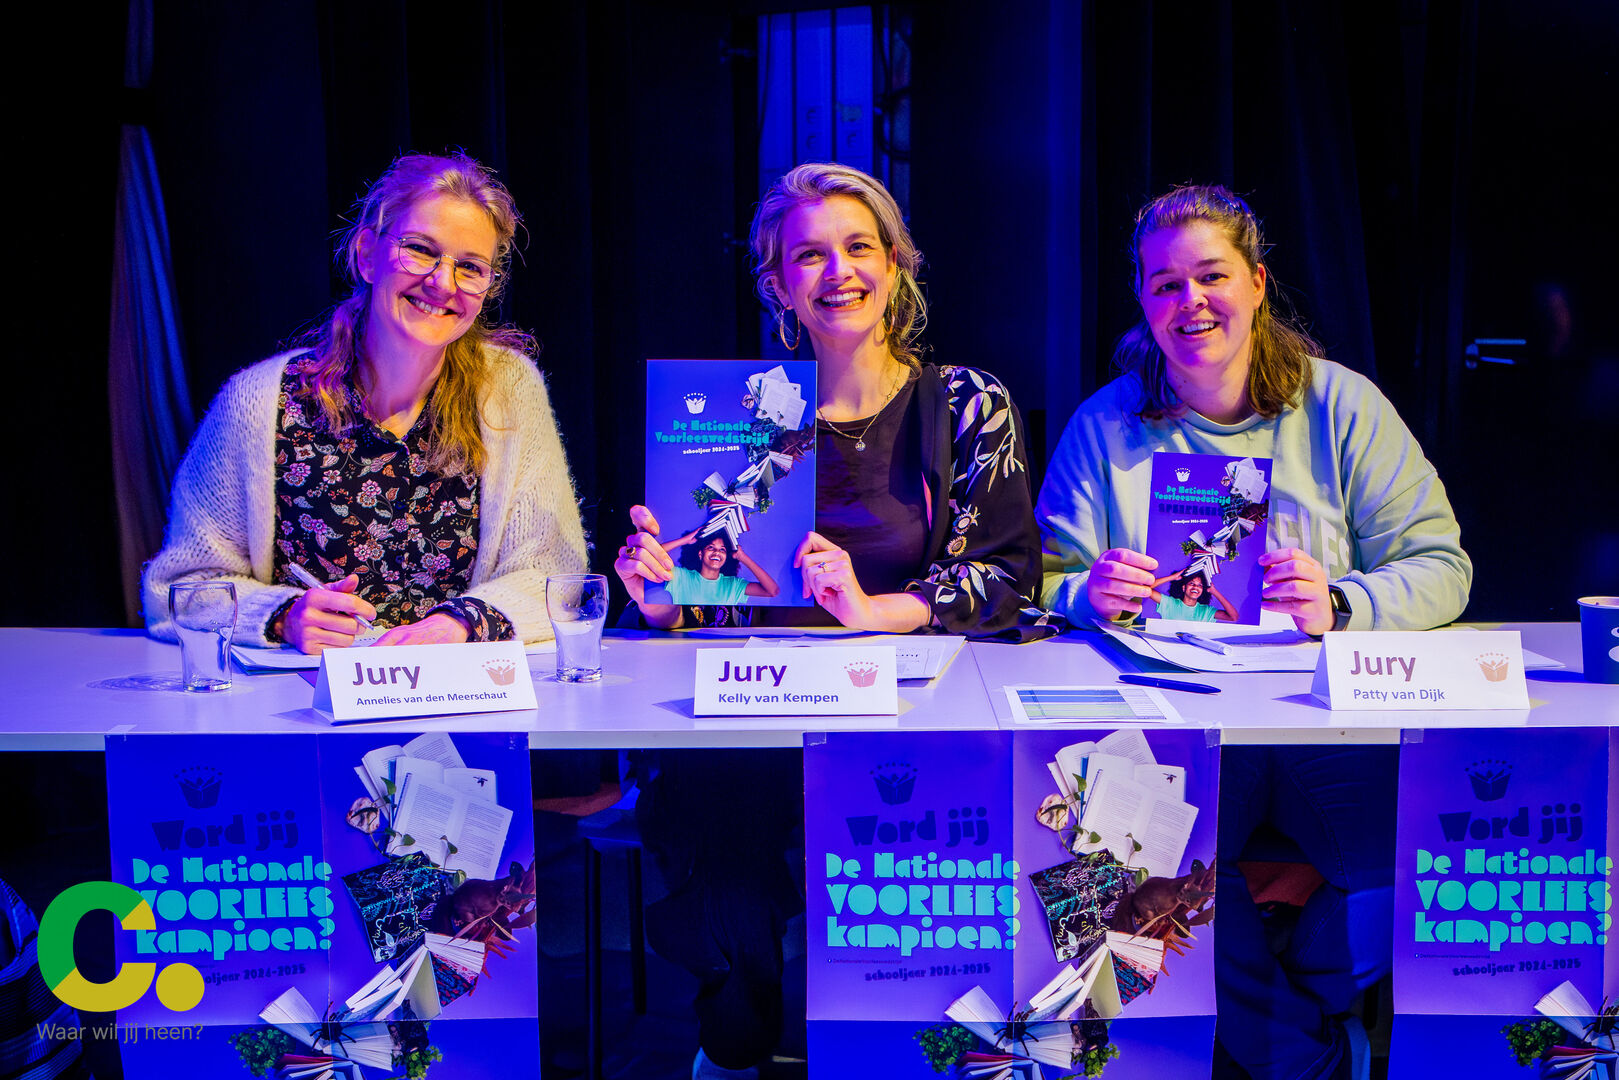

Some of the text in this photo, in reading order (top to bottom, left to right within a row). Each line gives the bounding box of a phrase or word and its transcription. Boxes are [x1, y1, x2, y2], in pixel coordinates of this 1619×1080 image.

[655, 432, 770, 446] Voorleeswedstrijd
[672, 420, 752, 431] De Nationale
[1166, 485, 1219, 496] De Nationale
[352, 662, 420, 689] Jury
[718, 661, 787, 687] Jury
[1350, 651, 1416, 681] Jury
[356, 691, 508, 706] Annelies van den Meerschaut
[718, 693, 839, 704] Kelly van Kempen
[1353, 689, 1445, 701] Patty van Dijk
[152, 810, 299, 851] Word jij
[846, 806, 989, 848] Word jij
[1438, 803, 1583, 844] Word jij
[133, 856, 333, 884] De Nationale
[826, 851, 1021, 880] De Nationale
[1416, 848, 1614, 876] De Nationale
[826, 884, 1021, 917] VOORLEES
[1415, 880, 1613, 912] VOORLEES
[136, 918, 336, 961] kampioen?
[827, 916, 1021, 956] kampioen?
[1415, 911, 1613, 951] kampioen?
[243, 964, 306, 980] 2024-2025
[865, 962, 991, 982] schooljaar 2024-2025
[1453, 958, 1581, 976] schooljaar 2024-2025
